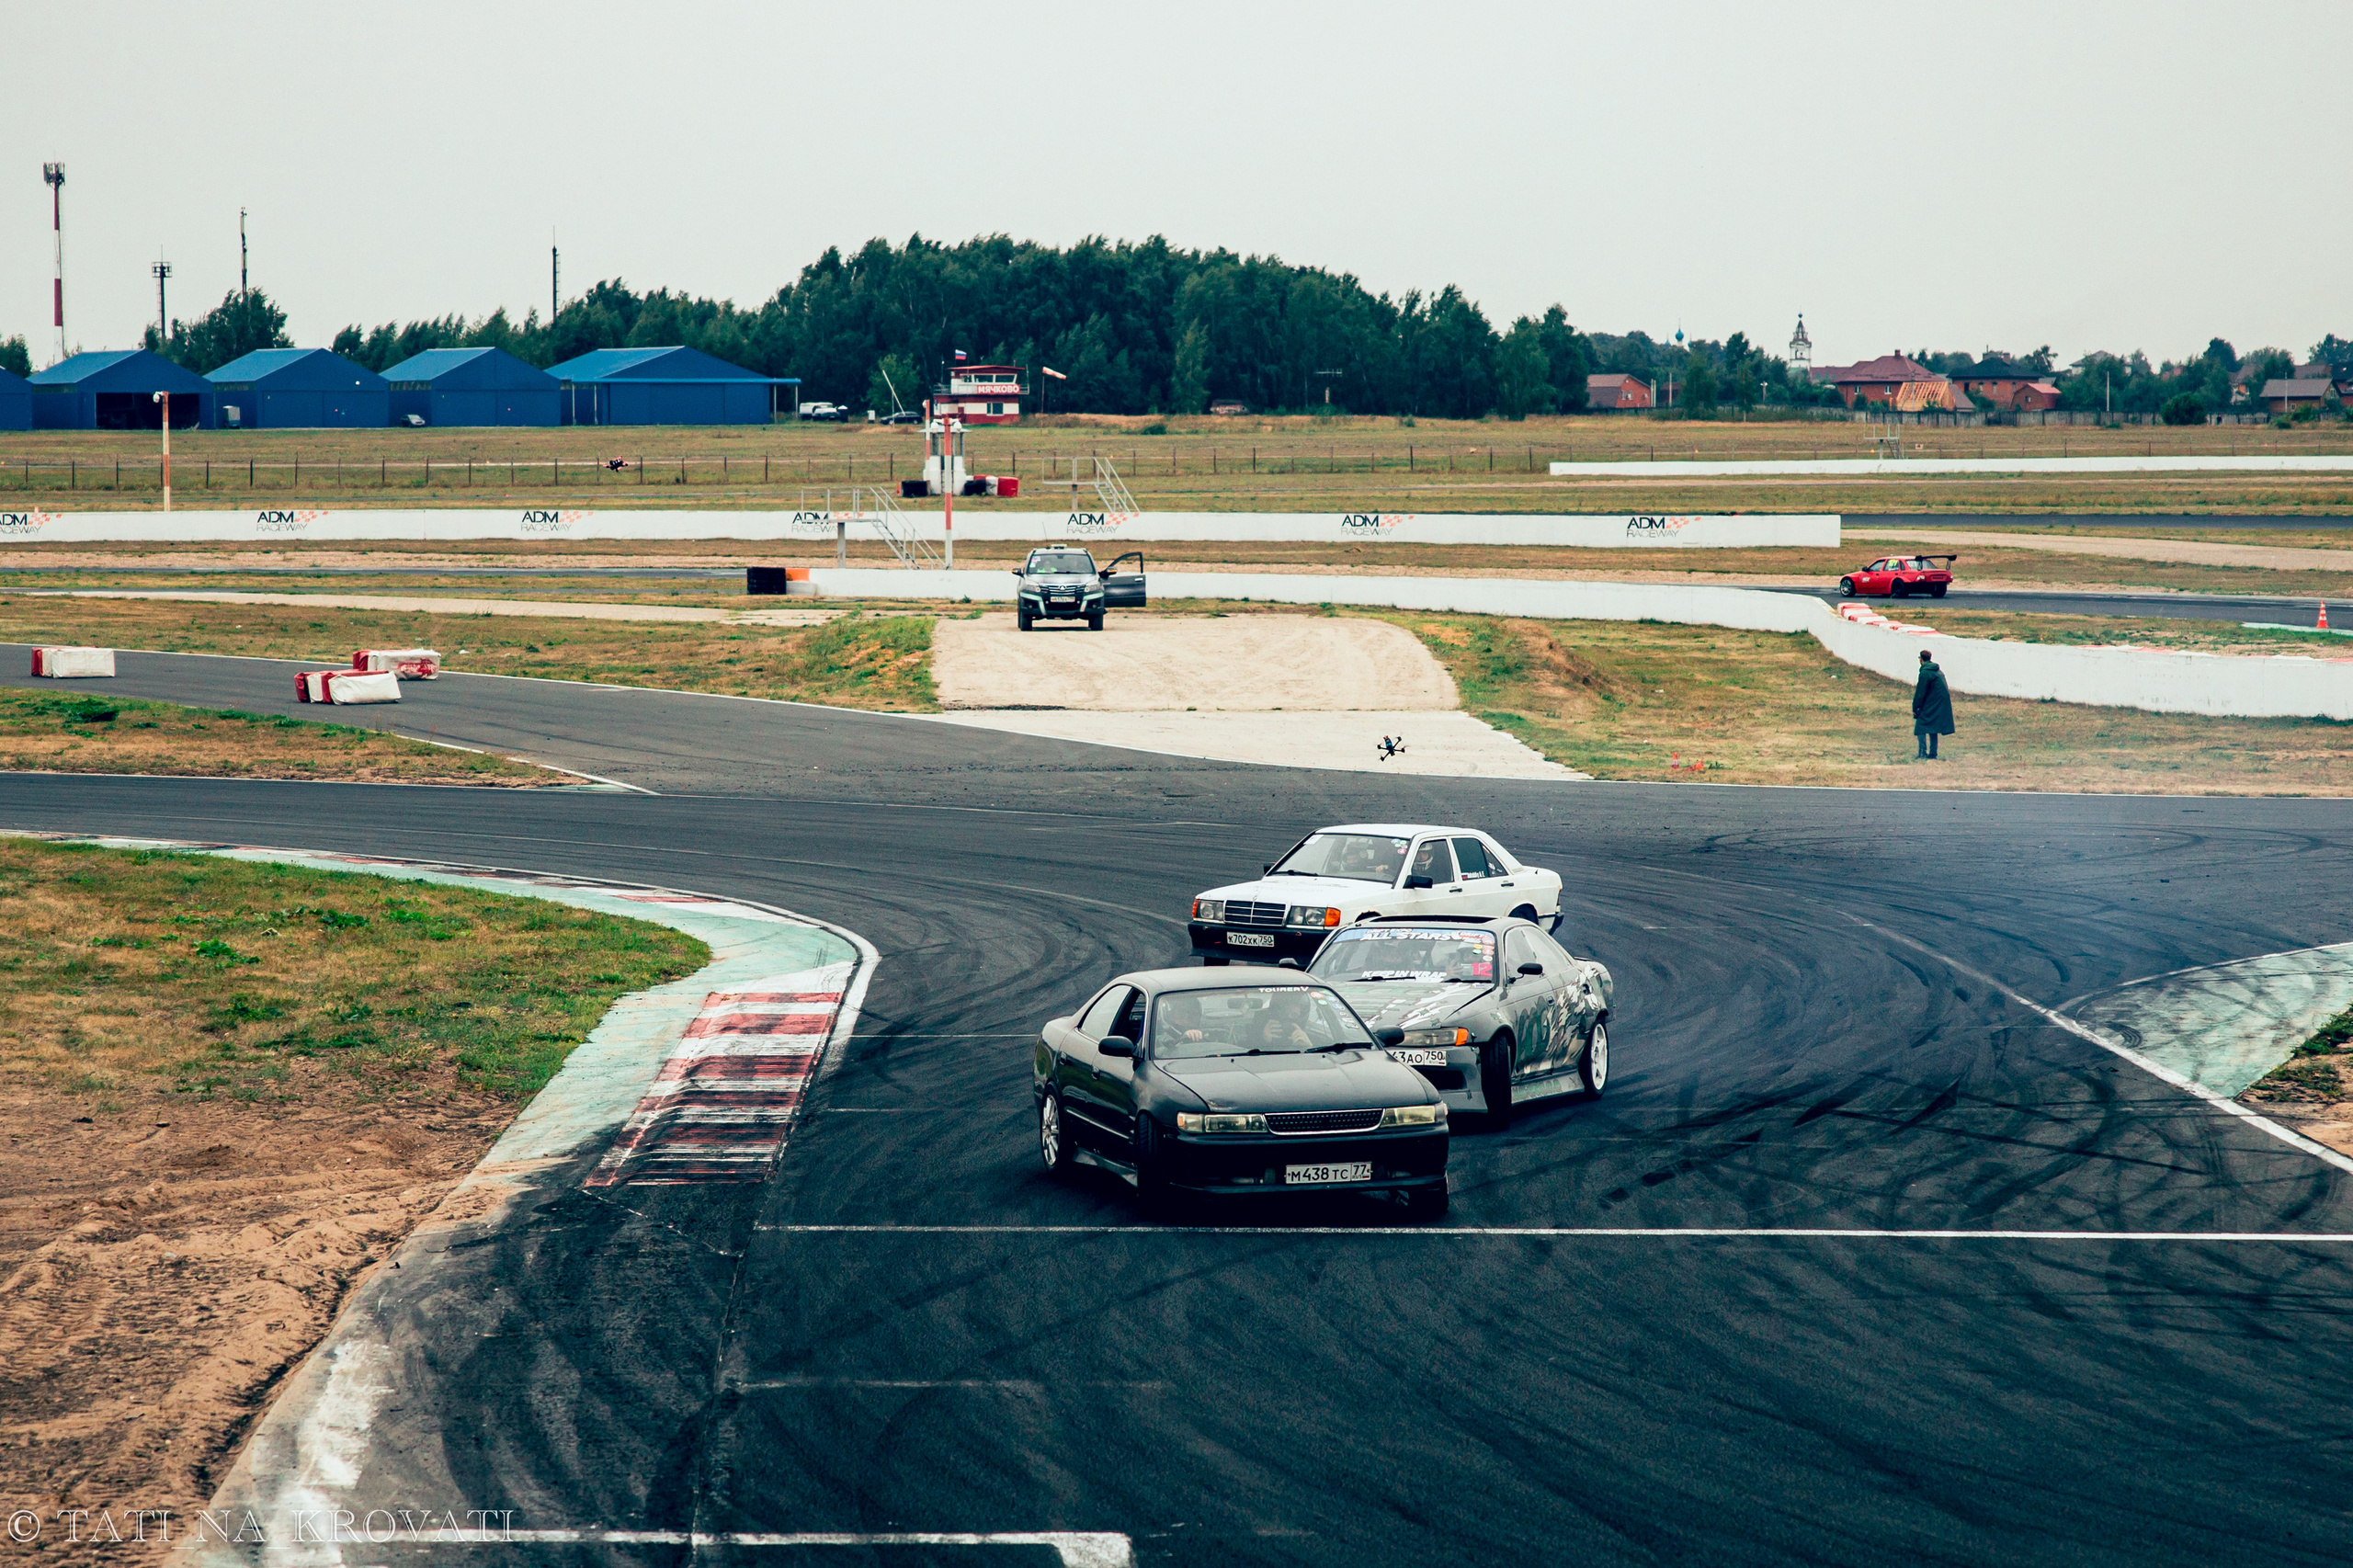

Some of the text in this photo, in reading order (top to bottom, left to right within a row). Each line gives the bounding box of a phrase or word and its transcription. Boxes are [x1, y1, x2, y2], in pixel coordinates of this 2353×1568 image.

[978, 385, 1020, 393] МЯЧКОВО
[0, 513, 28, 526] DM
[257, 511, 294, 523] ADM
[522, 511, 559, 523] ADM
[792, 512, 829, 524] ADM
[1068, 513, 1105, 525] ADM
[1342, 515, 1379, 527] ADM
[256, 523, 308, 531] RACEWAY
[521, 523, 572, 531] RACEWAY
[1628, 517, 1665, 528] ADM
[0, 526, 41, 534] ACEWAY
[791, 525, 838, 533] RACEWA
[1066, 526, 1119, 534] RACEWAY
[1340, 528, 1393, 536] RACEWAY
[1626, 529, 1679, 538] RACEWAY
[1360, 932, 1451, 941] ALL STARS
[1472, 962, 1493, 977] 12
[1410, 971, 1448, 979] WRAP
[1426, 1051, 1443, 1061] 750
[1353, 1165, 1367, 1176] 77
